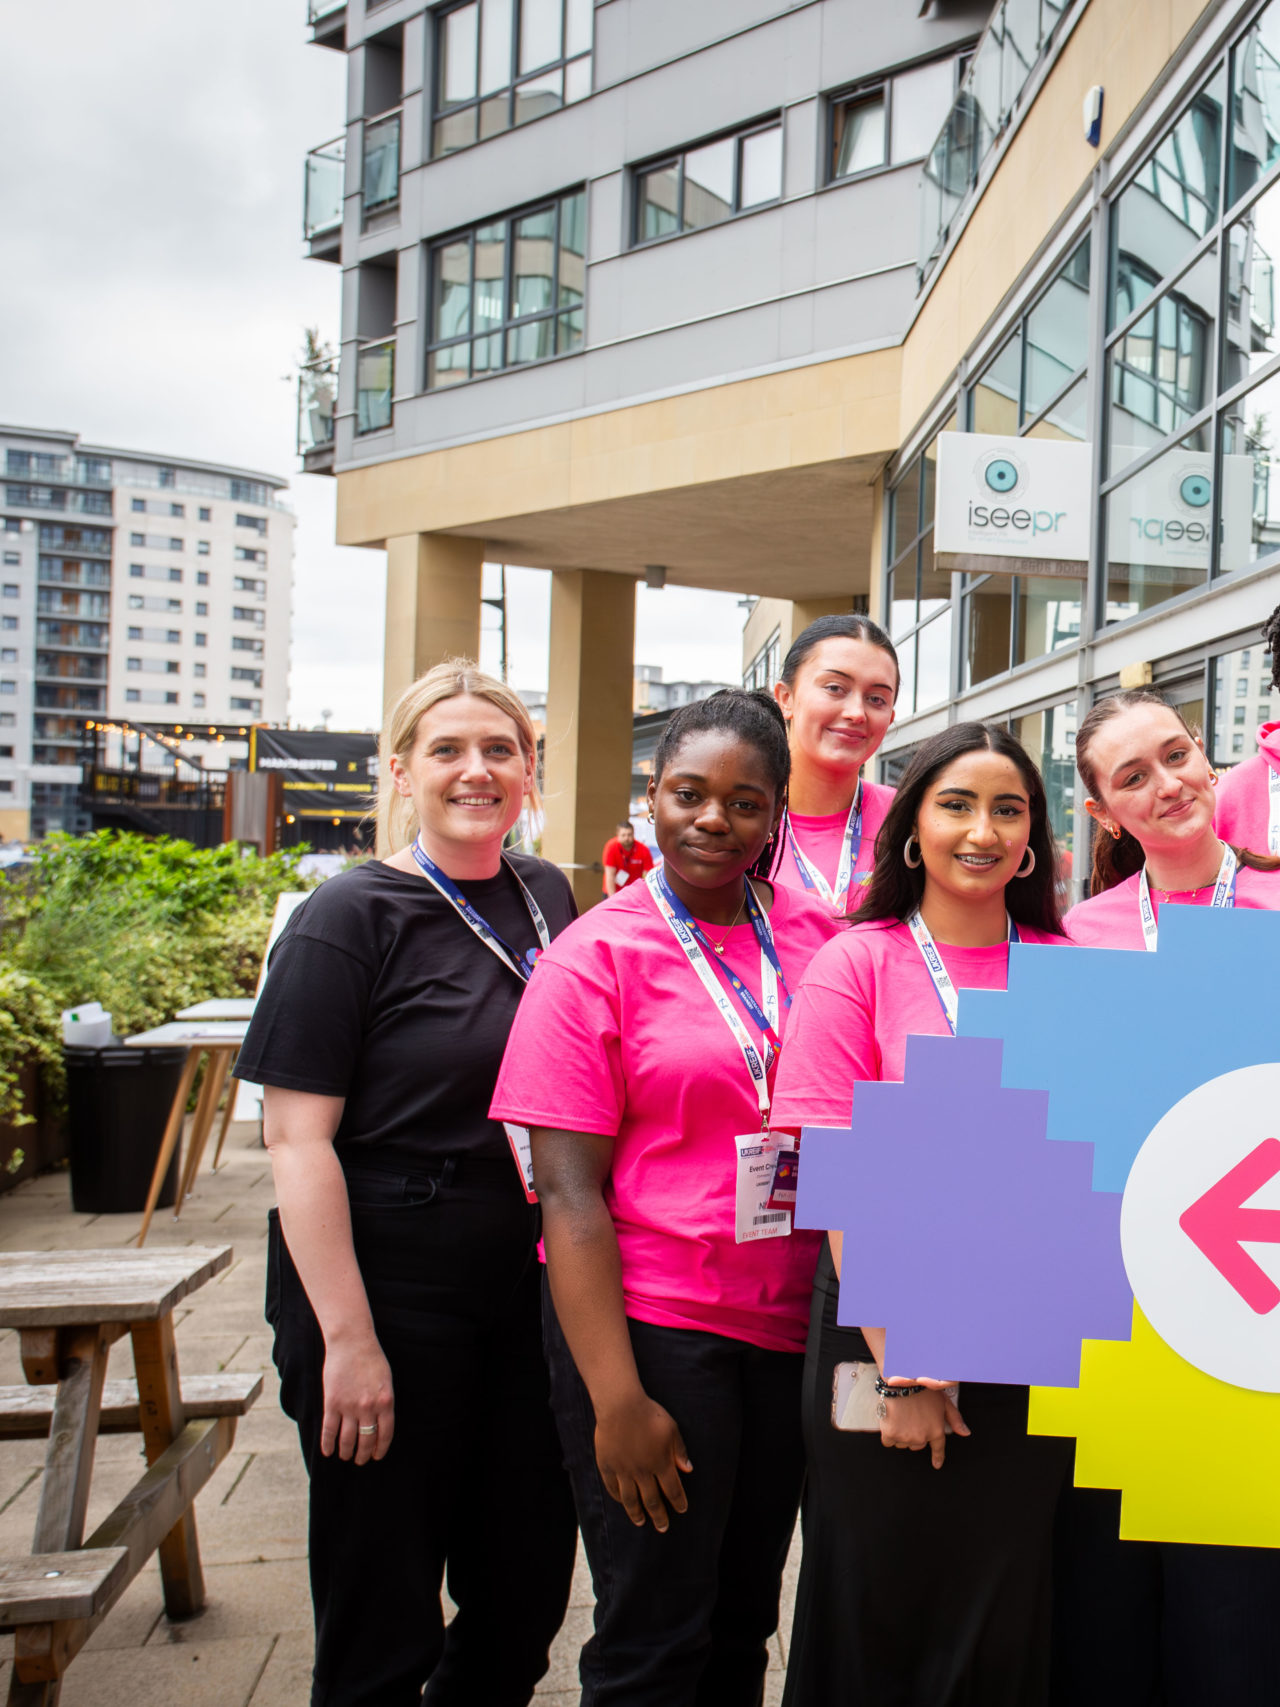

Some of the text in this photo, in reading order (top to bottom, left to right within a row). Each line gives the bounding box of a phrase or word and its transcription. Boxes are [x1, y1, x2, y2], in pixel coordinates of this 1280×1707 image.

[969, 500, 1067, 536] iseepr
[749, 1164, 765, 1173] Event
[742, 1227, 778, 1240] EVENT TEAM
